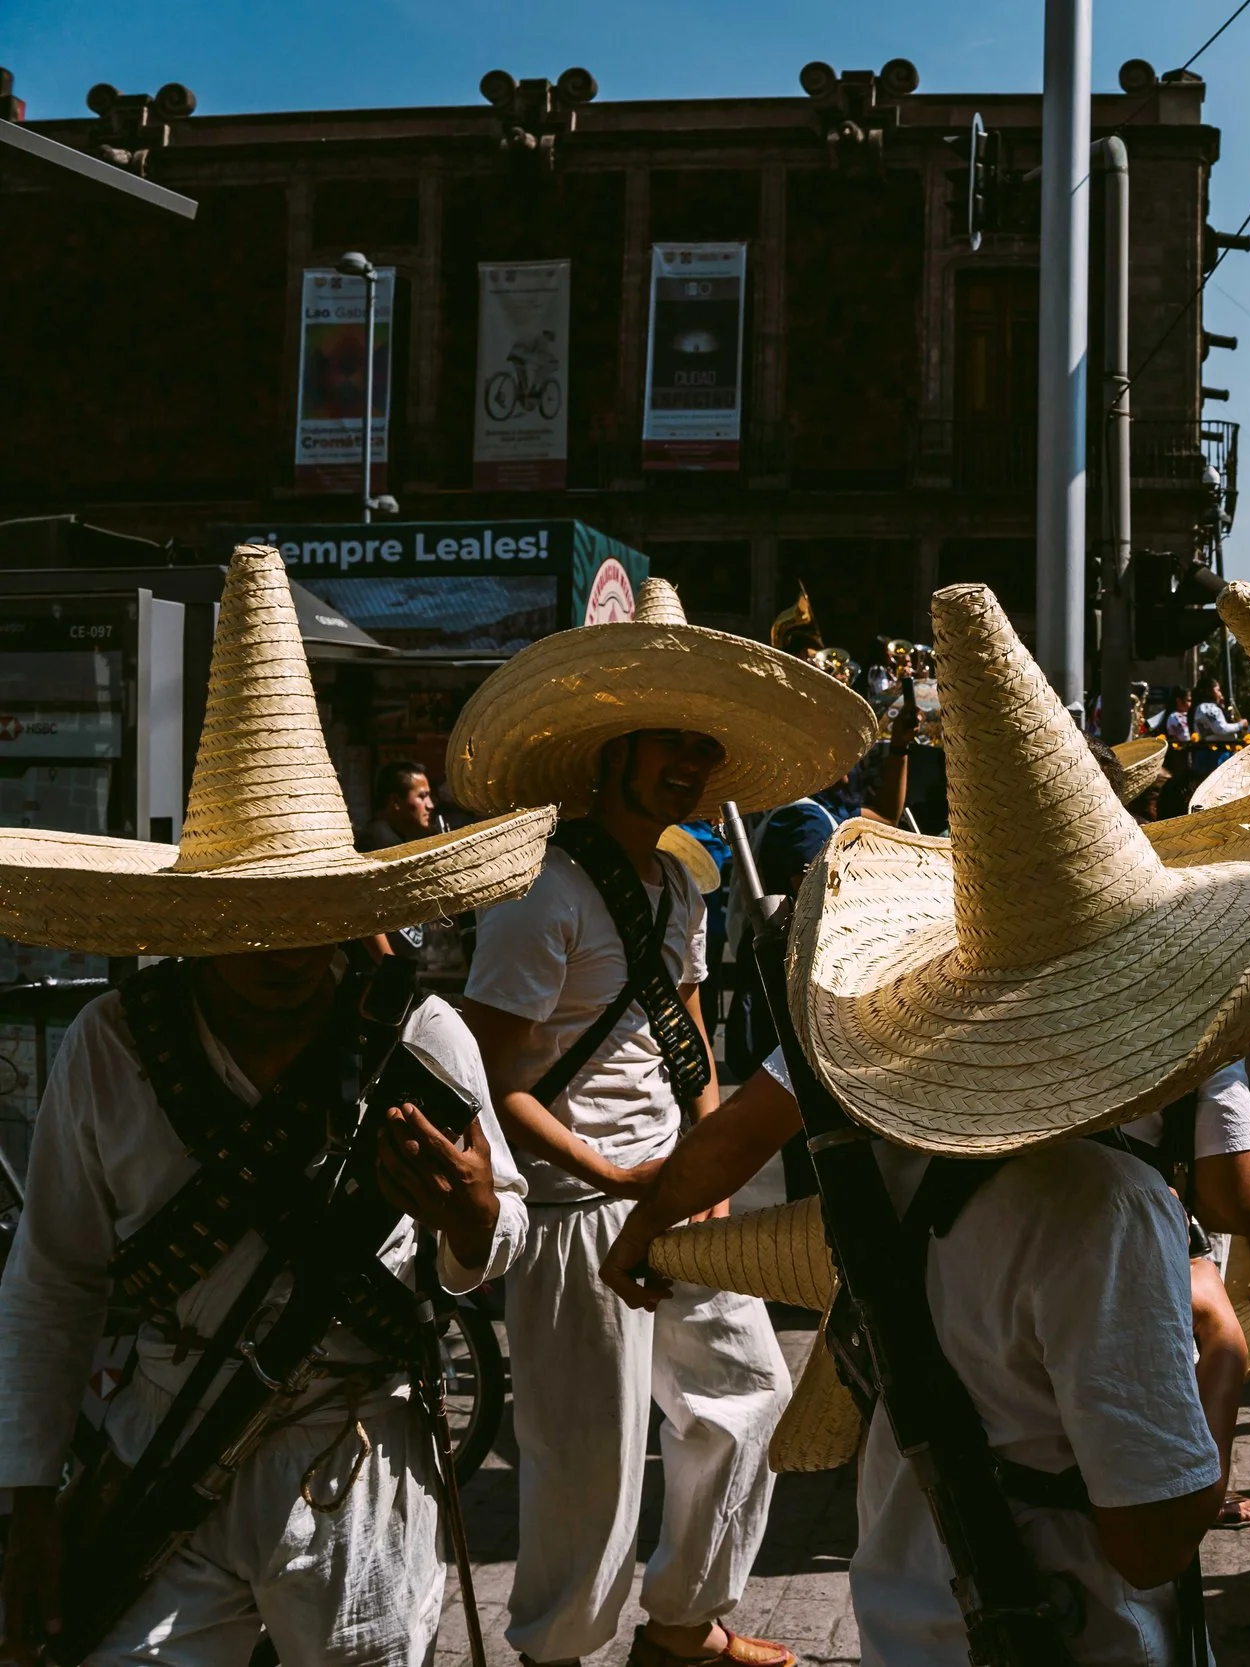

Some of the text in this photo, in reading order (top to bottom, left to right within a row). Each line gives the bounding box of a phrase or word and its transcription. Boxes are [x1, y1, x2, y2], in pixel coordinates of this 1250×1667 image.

[674, 370, 717, 386] CIUDAD
[415, 530, 549, 561] Leales!
[69, 625, 113, 639] CE-097
[26, 723, 58, 735] HSBC
